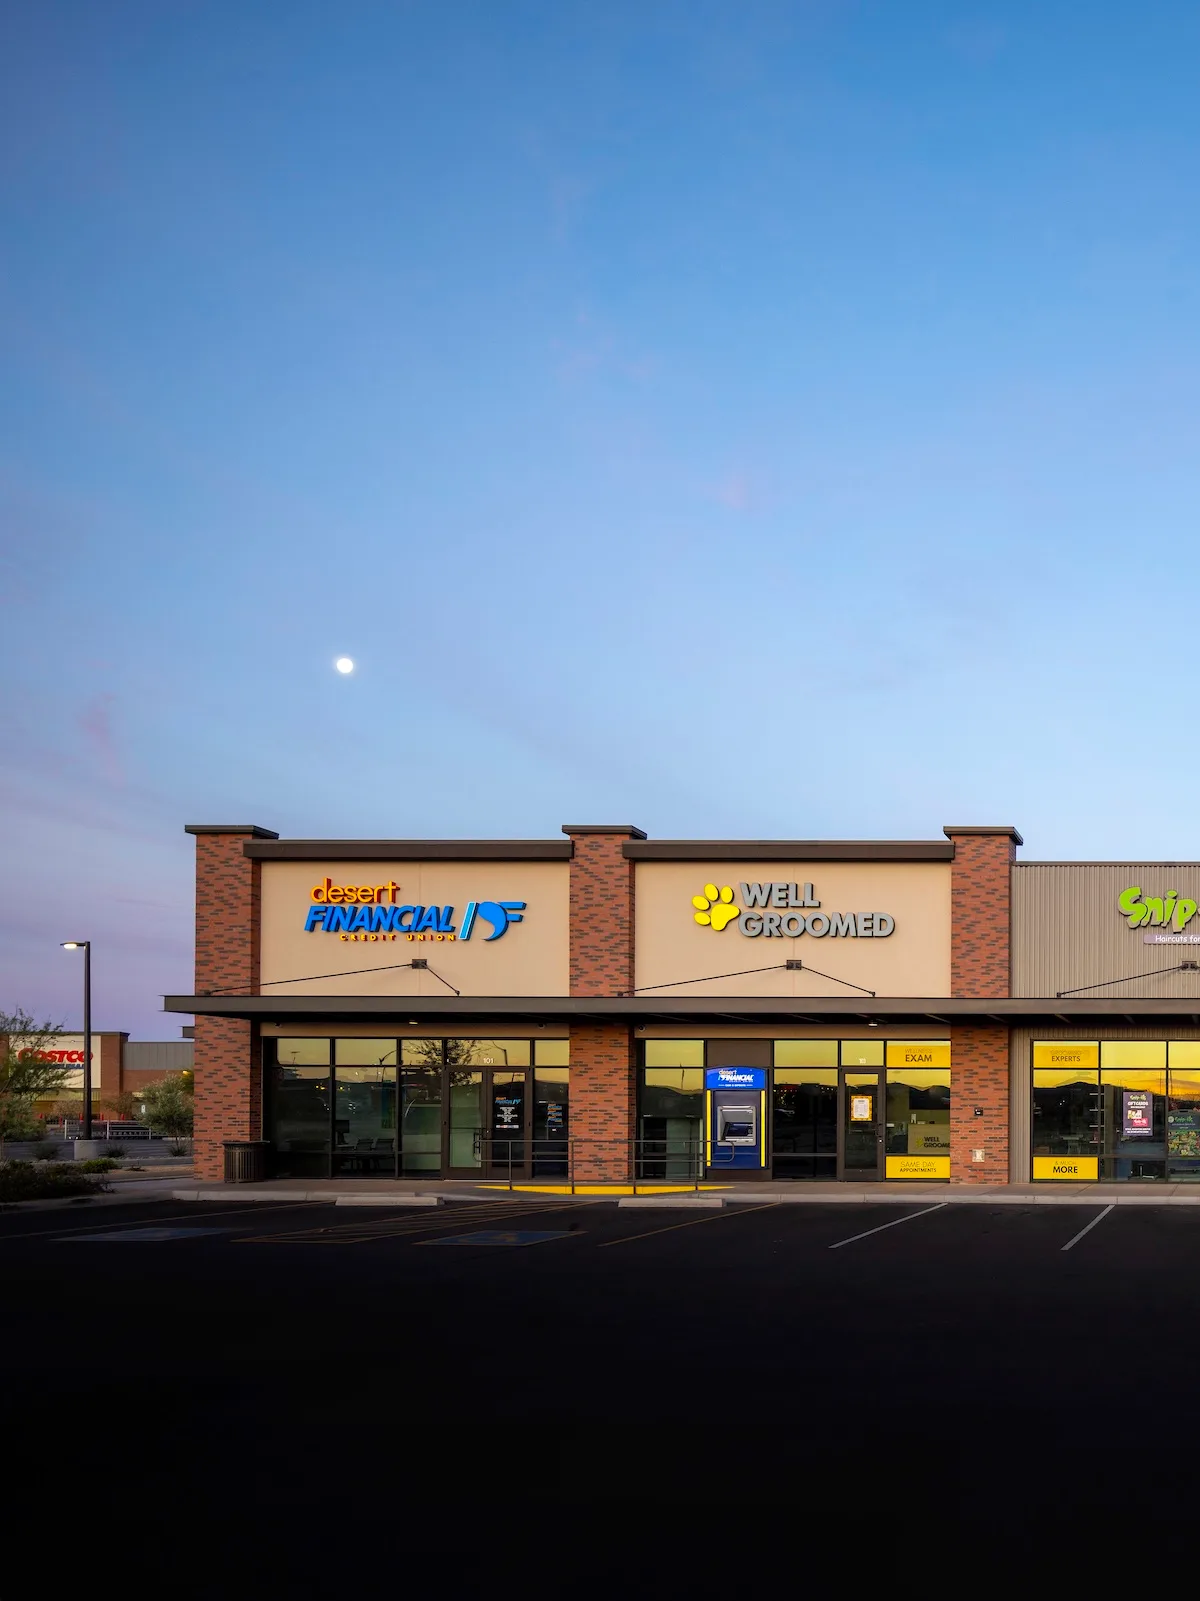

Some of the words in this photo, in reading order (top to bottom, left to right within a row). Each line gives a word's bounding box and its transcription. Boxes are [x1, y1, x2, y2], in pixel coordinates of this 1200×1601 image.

[310, 878, 400, 904] desert
[739, 882, 821, 908] WELL
[304, 905, 456, 932] FINANCIAL
[738, 911, 895, 938] GROOMED
[1155, 934, 1188, 943] Haircuts
[905, 1054, 932, 1062] EXAM
